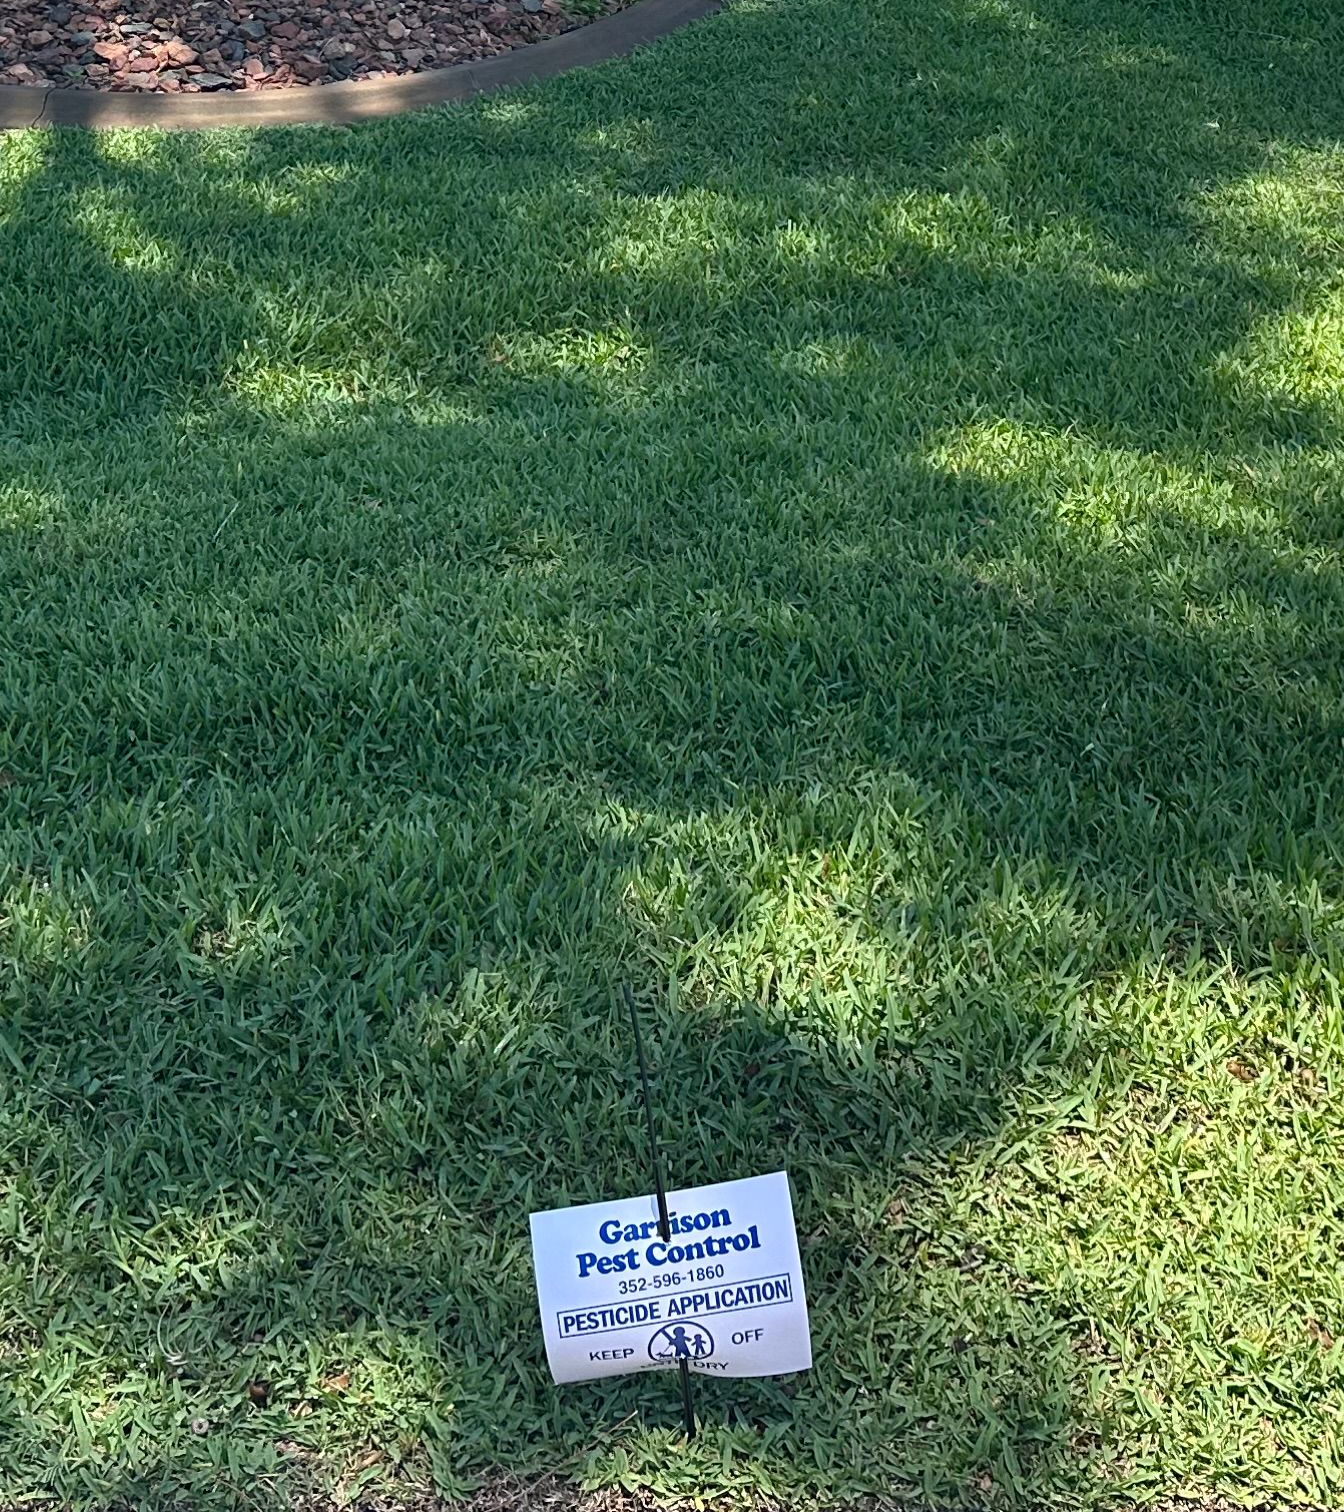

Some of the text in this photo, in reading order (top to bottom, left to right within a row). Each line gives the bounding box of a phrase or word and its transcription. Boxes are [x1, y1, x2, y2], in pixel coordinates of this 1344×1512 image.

[599, 1209, 731, 1244] Garison
[576, 1225, 761, 1278] Pest Control
[618, 1264, 725, 1295] 352-596-1860
[563, 1280, 788, 1333] PESTICIDE APPLICATION
[589, 1328, 765, 1361] KEEP OFF
[693, 1361, 729, 1371] DRY
